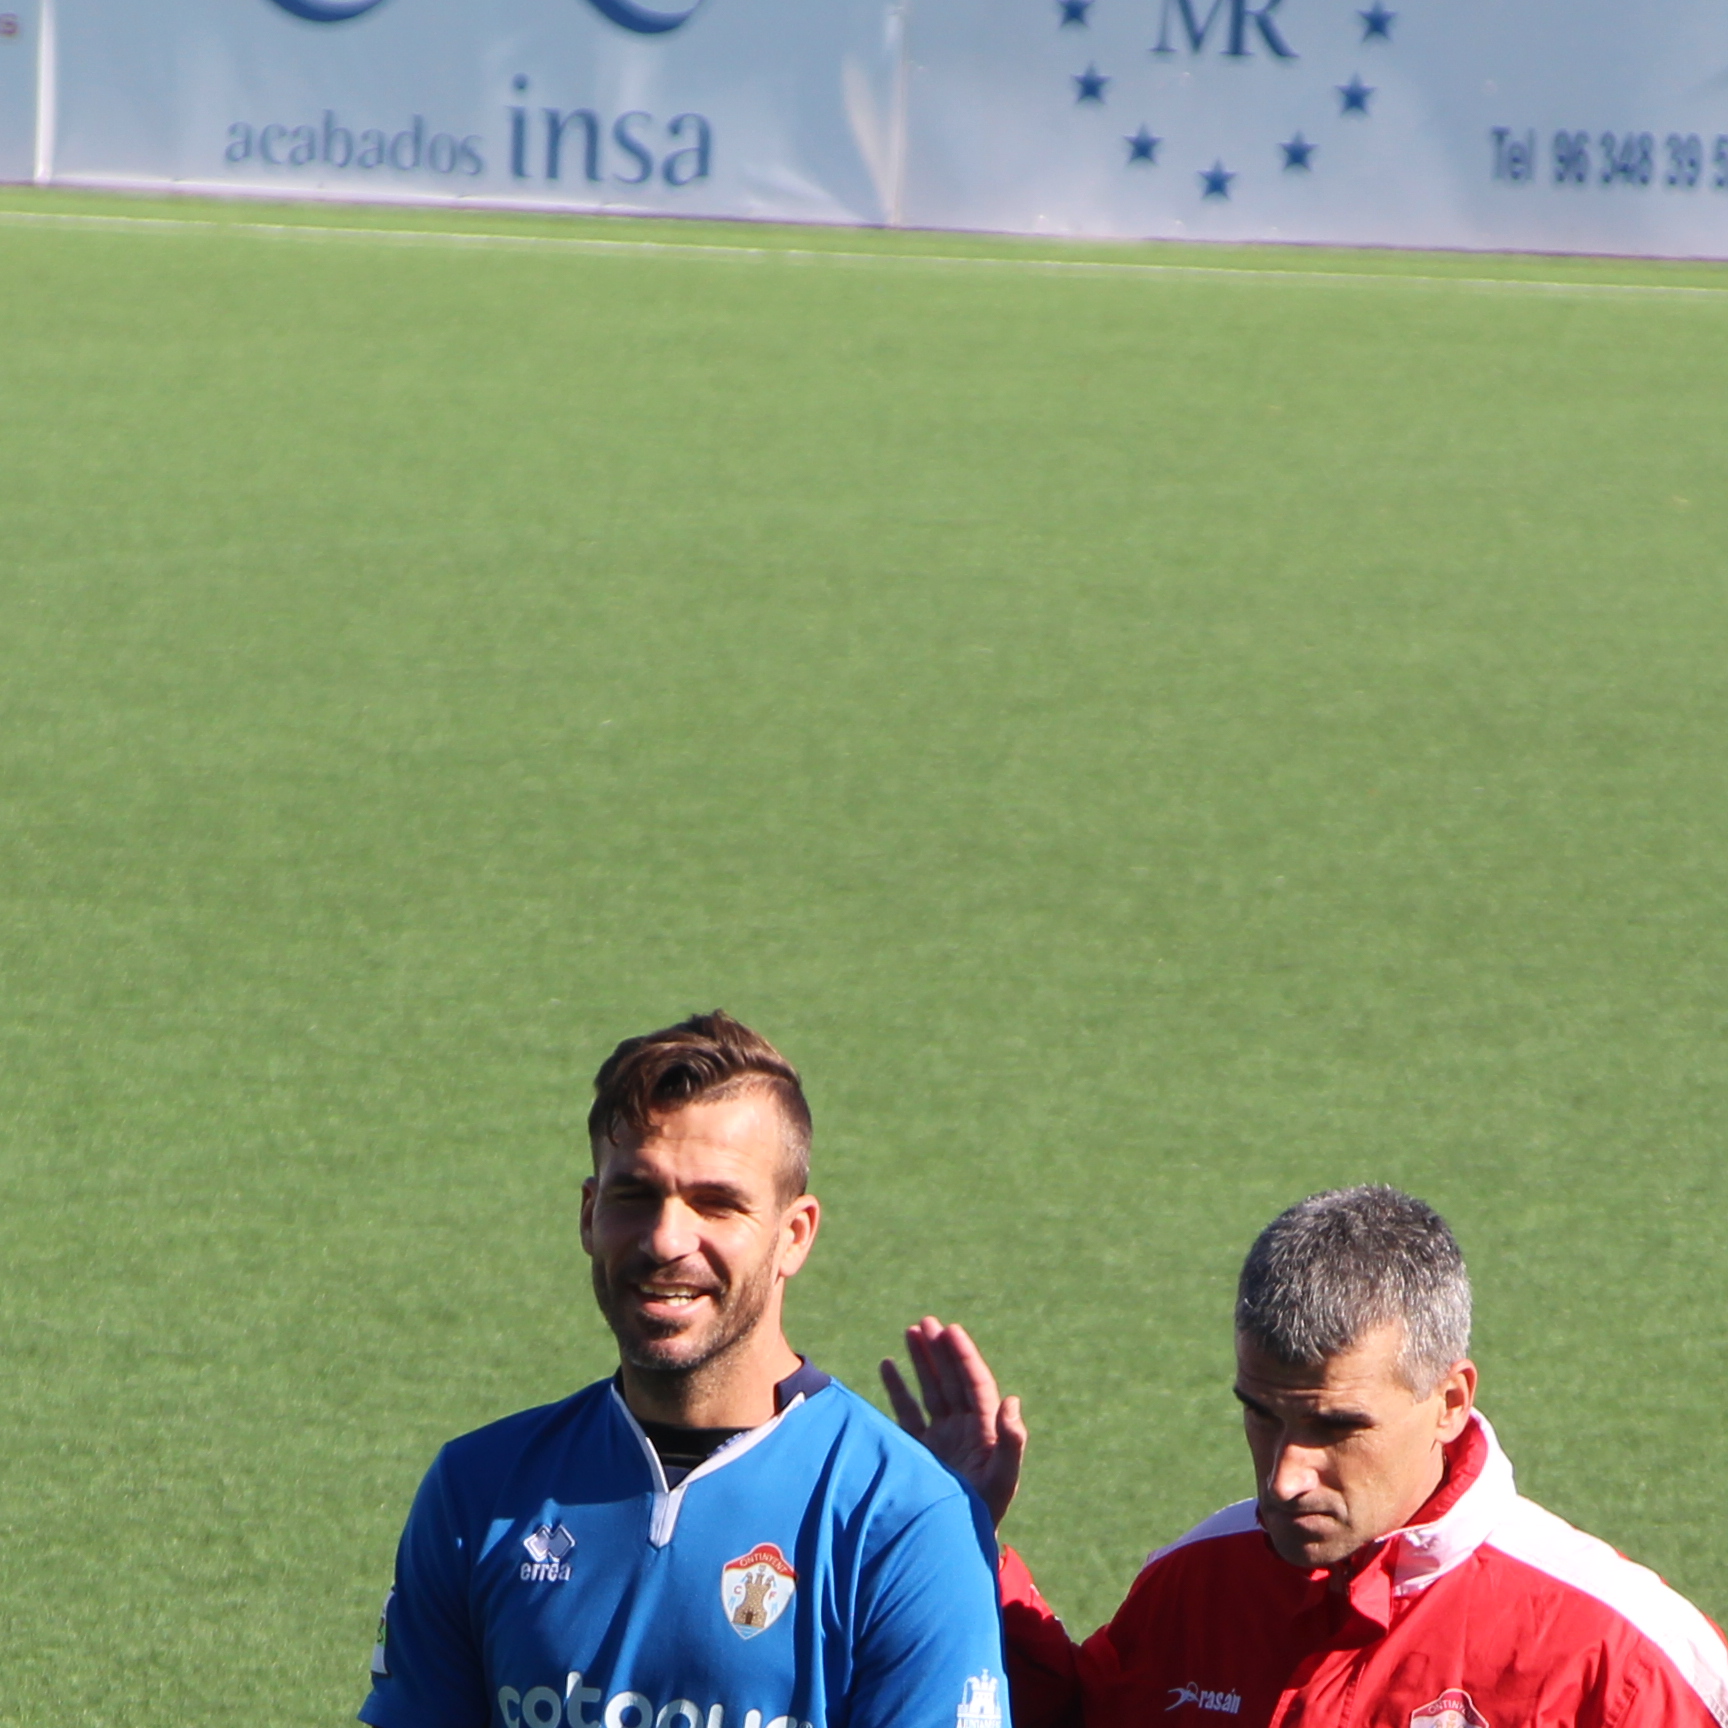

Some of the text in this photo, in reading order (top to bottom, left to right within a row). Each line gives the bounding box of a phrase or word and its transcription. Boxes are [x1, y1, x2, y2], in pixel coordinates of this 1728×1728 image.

[1148, 0, 1302, 58] MR
[223, 72, 714, 187] acabados insa
[1489, 125, 1536, 182] Tel
[1552, 129, 1591, 184] 96
[1599, 130, 1656, 186] 348
[1666, 132, 1702, 188] 39
[739, 1551, 788, 1575] ONTINYENT
